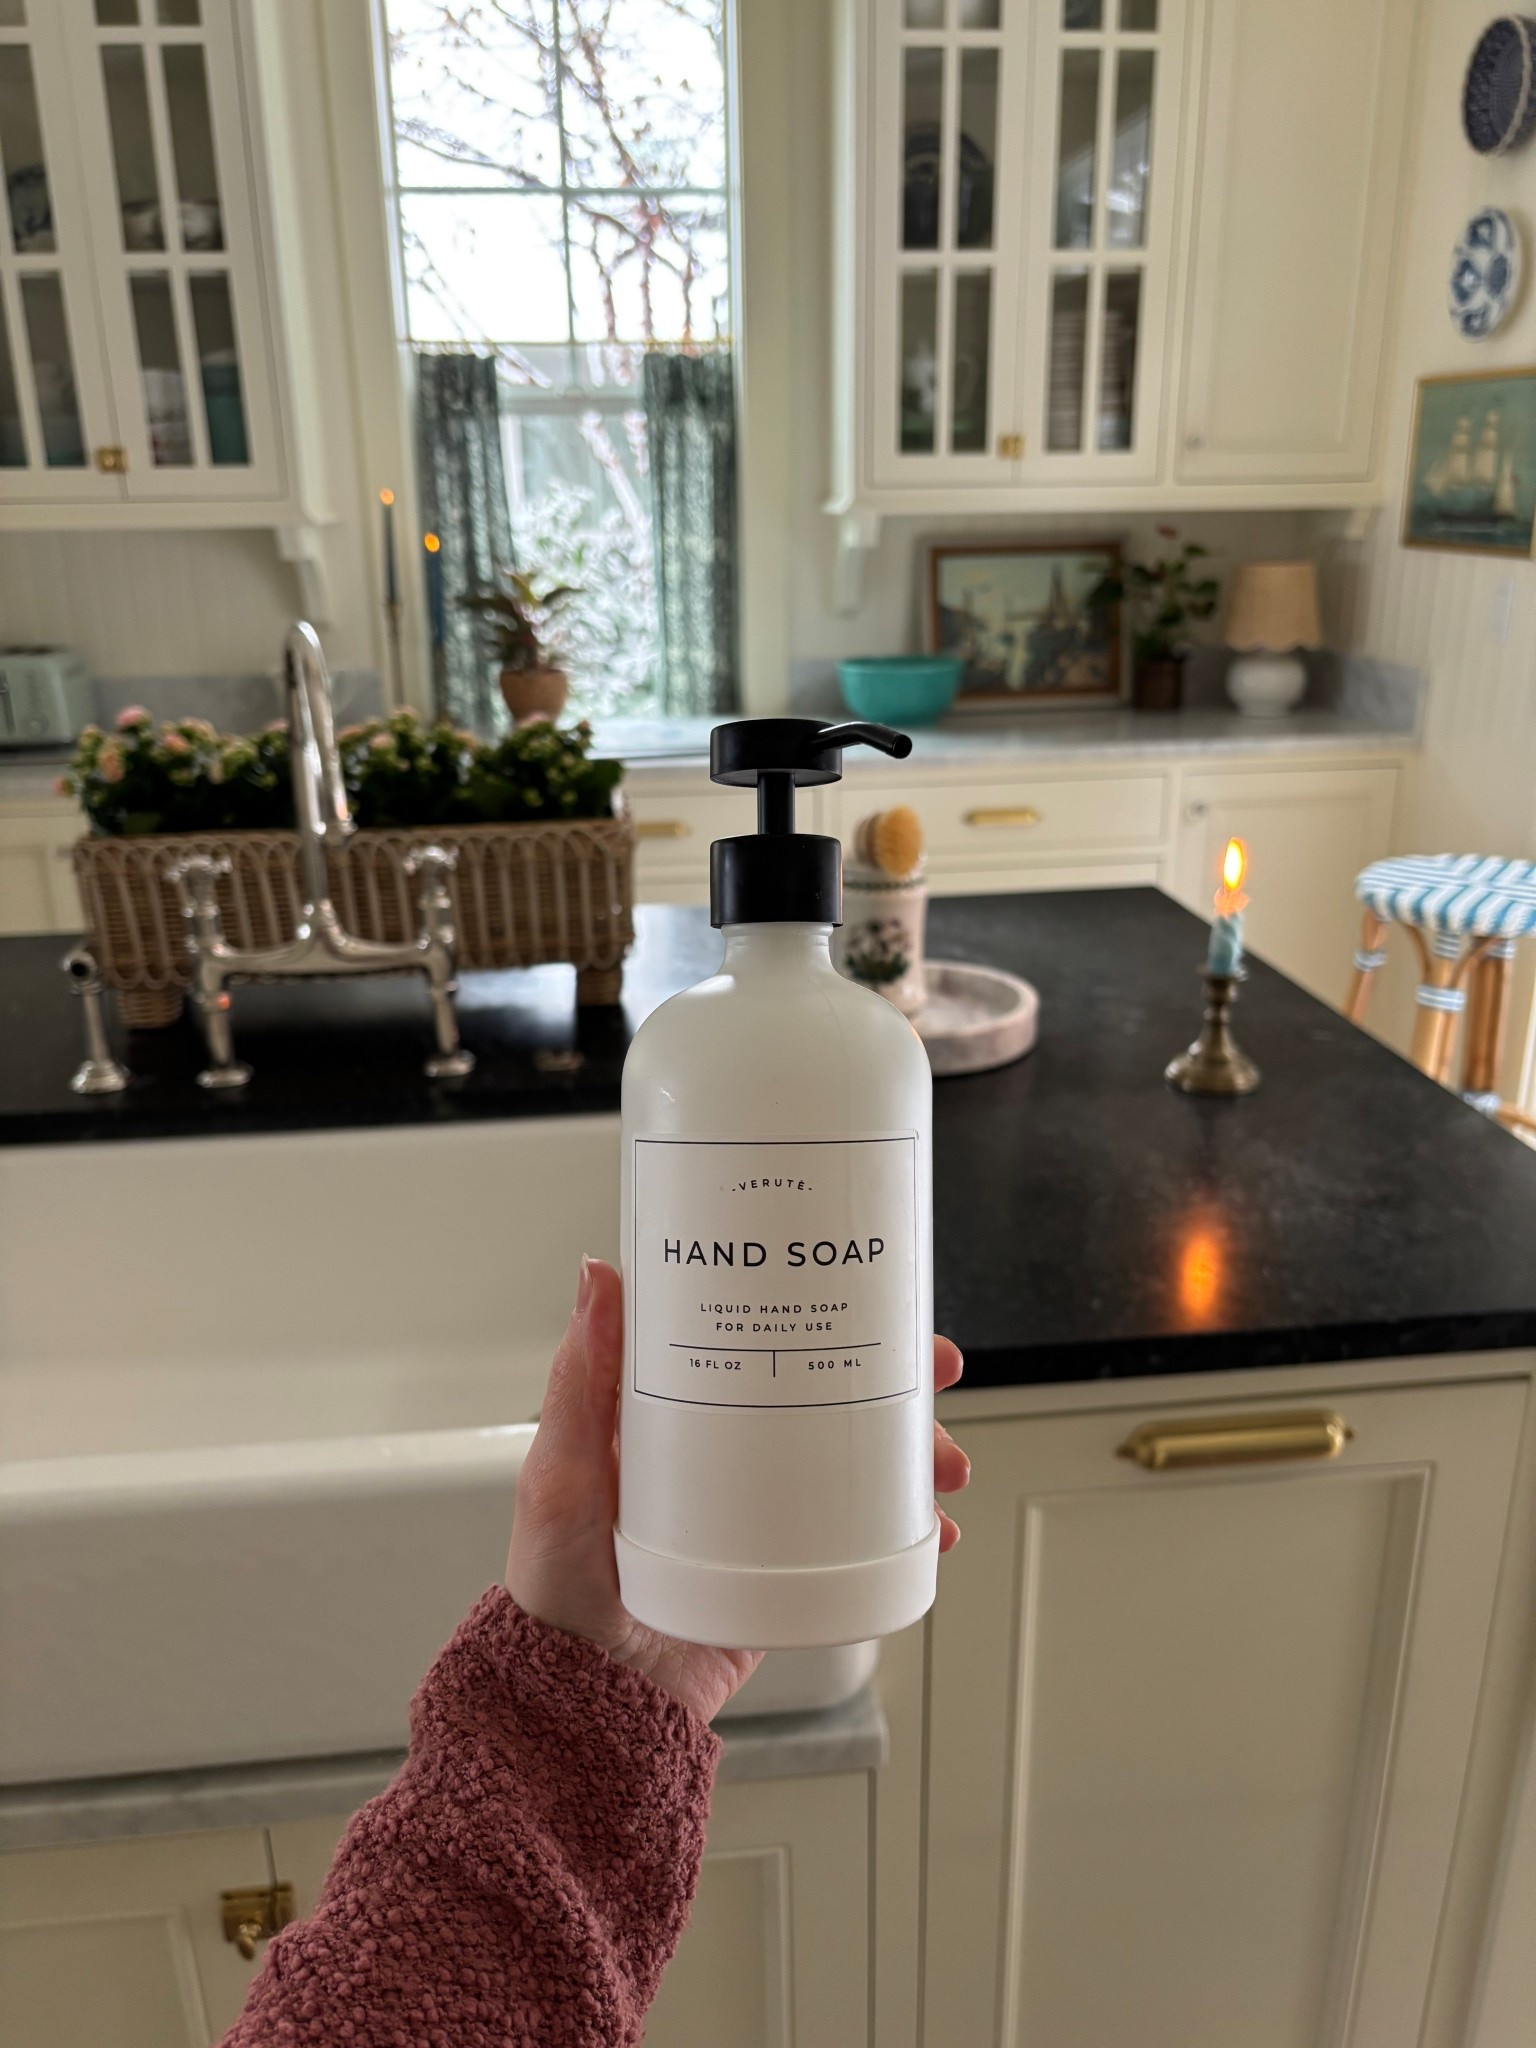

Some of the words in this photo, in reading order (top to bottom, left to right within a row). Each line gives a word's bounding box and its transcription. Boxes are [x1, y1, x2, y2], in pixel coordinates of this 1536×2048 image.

[664, 1238, 767, 1268] HAND
[787, 1237, 885, 1268] SOAP
[700, 1302, 752, 1315] LIQUID
[759, 1304, 802, 1314] HAND
[810, 1302, 848, 1313] SOAP
[715, 1321, 744, 1332] FOR
[752, 1322, 797, 1333] DAILY
[805, 1321, 833, 1332] USE
[689, 1357, 701, 1368] 16
[705, 1359, 720, 1370] FL
[724, 1360, 742, 1371] OZ
[807, 1360, 835, 1371] 500
[843, 1357, 862, 1368] ML
